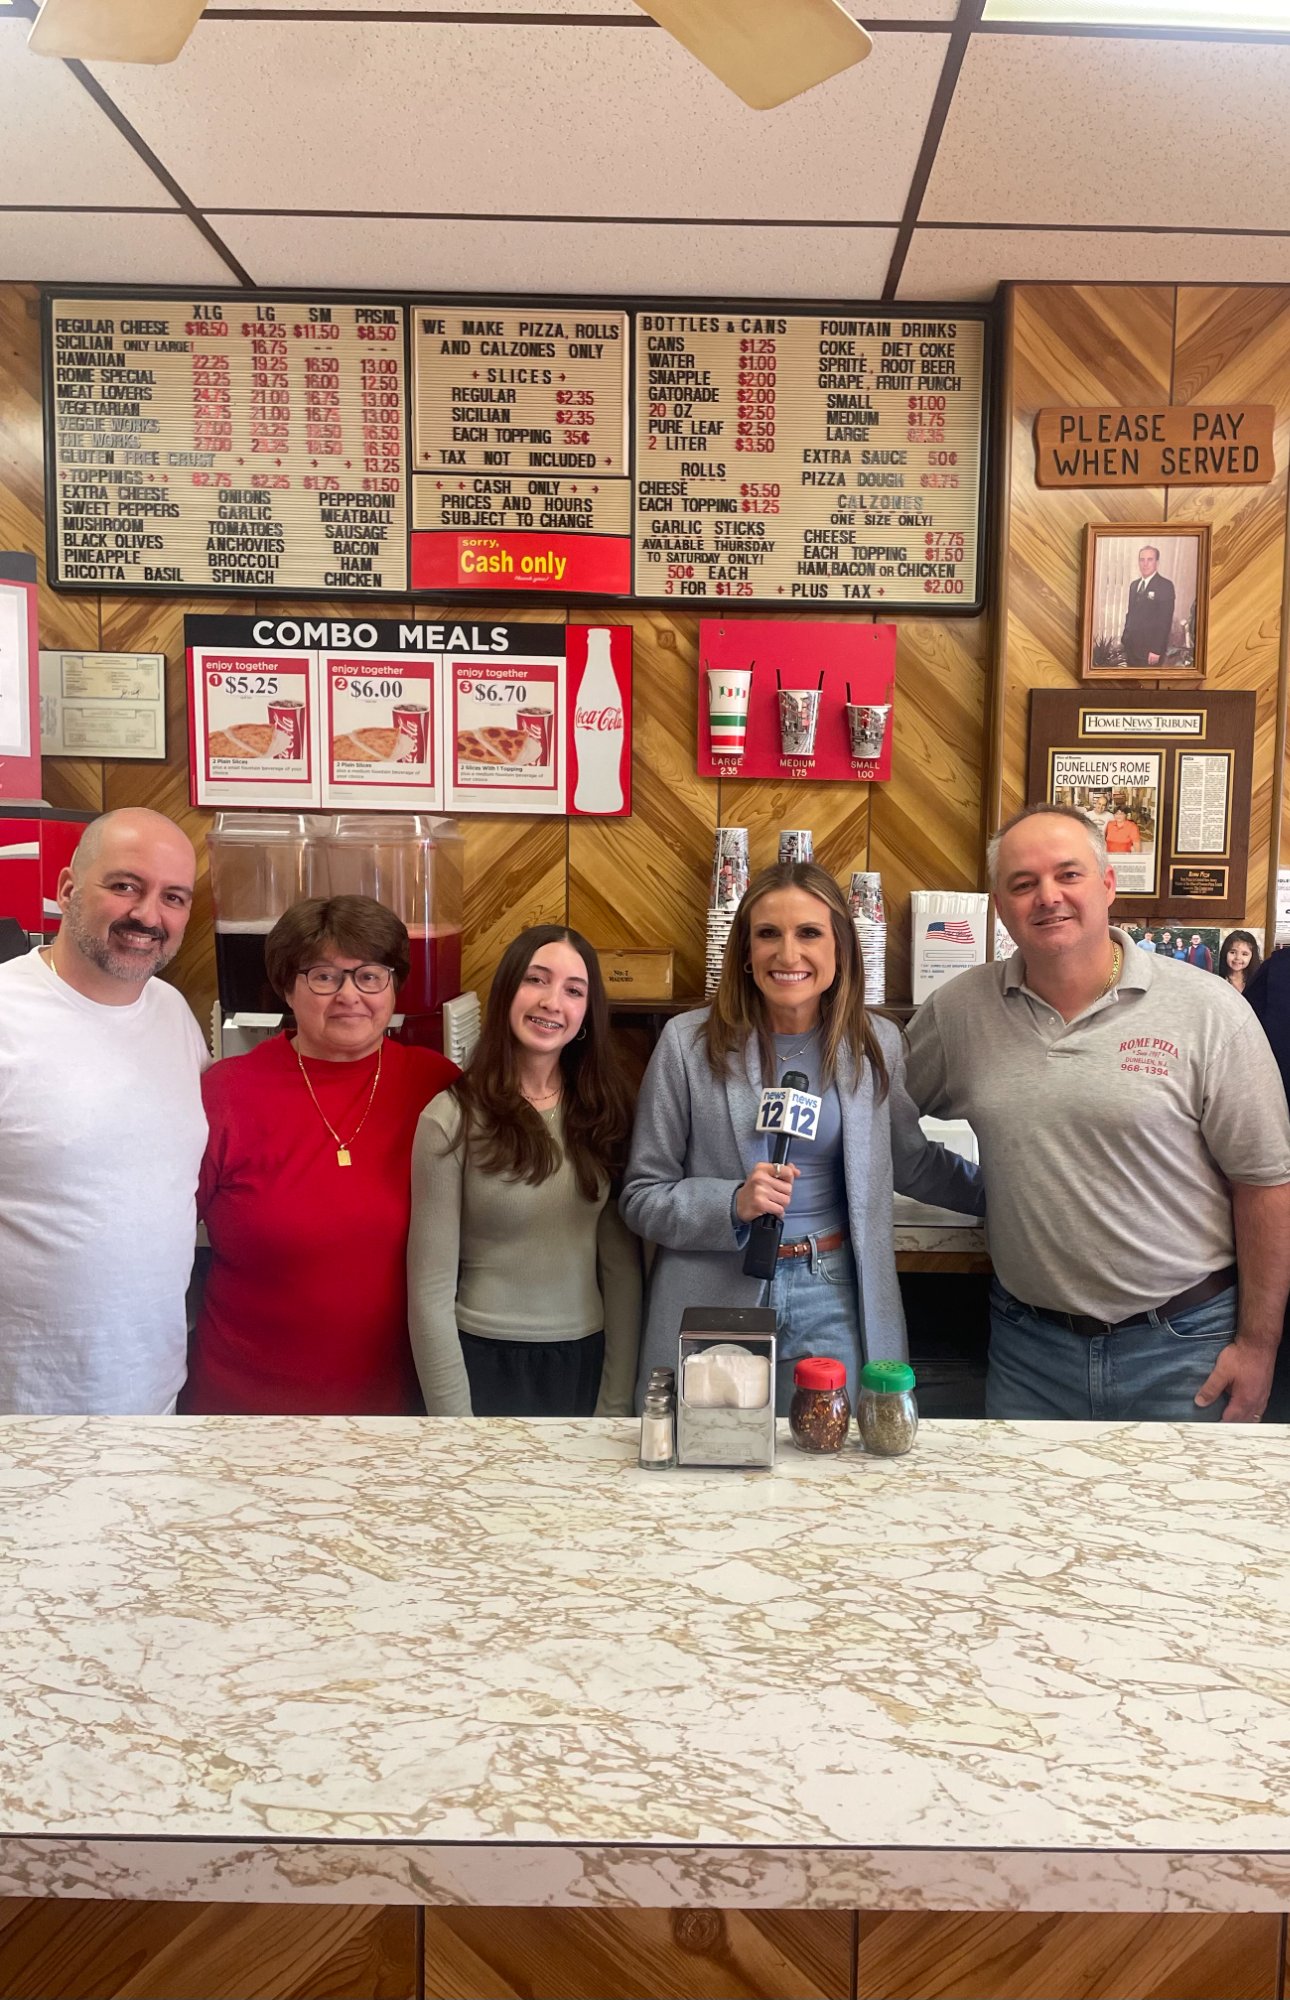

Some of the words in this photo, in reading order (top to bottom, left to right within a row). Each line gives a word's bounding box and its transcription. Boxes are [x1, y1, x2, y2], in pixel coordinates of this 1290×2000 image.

[193, 305, 222, 320] XLG
[257, 306, 275, 321] LG
[309, 308, 332, 322] SM
[56, 319, 114, 334] REGULAR
[120, 320, 169, 335] CHEESE
[423, 320, 445, 334] WE
[462, 320, 504, 336] MAKE
[576, 324, 619, 340] ROLLS
[643, 316, 720, 332] BOTTLES
[742, 319, 786, 334] CANS
[821, 321, 890, 336] FOUNTAIN
[902, 322, 956, 338] DRINKS
[56, 335, 112, 350] SICILIAN
[441, 340, 470, 354] AND
[481, 341, 555, 358] CALZONES
[569, 344, 603, 359] ONLY
[648, 336, 684, 352] CANS
[882, 342, 912, 357] DIET
[920, 344, 955, 358] COKE
[56, 352, 125, 367] HAWAIIAN
[648, 354, 694, 368] WATER
[881, 360, 915, 374] ROOT
[922, 360, 955, 374] BEER
[101, 370, 156, 384] SPECIAL
[648, 370, 710, 385] SNAPPLE
[876, 376, 913, 390] FRUIT
[918, 376, 961, 391] PUNCH
[58, 384, 94, 398] MEAT
[452, 387, 516, 403] REGULAR
[648, 387, 720, 402] GATORADE
[827, 394, 872, 409] SMALL
[452, 408, 510, 423] SICILIAN
[649, 403, 666, 417] 20
[674, 404, 692, 418] OZ
[827, 411, 879, 426] MEDIUM
[649, 420, 682, 434] PURE
[692, 420, 724, 435] LEAF
[1060, 413, 1166, 443] PLEASE
[1192, 413, 1244, 440] PAY
[452, 427, 488, 442] EACH
[495, 428, 551, 444] TOPPING
[649, 436, 656, 450] 2
[667, 437, 706, 450] LITER
[440, 450, 466, 464] TAX
[484, 452, 510, 466] NOT
[529, 452, 596, 468] INCLUDED
[804, 450, 851, 464] EXTRA
[1053, 448, 1140, 476] WHEN
[1161, 446, 1259, 476] SERVED
[681, 462, 726, 477] ROLLS
[802, 472, 846, 486] PIZZA
[63, 485, 108, 500] EXTRA
[118, 486, 168, 501] CHEESE
[474, 480, 511, 494] CASH
[528, 481, 560, 495] ONLY
[639, 481, 688, 496] CHEESE
[320, 492, 394, 508] PEPPERONI
[442, 495, 491, 509] PRICES
[502, 496, 531, 510] AND
[544, 498, 592, 512] HOURS
[639, 498, 672, 511] EACH
[682, 498, 737, 512] TOPPING
[63, 501, 110, 515] SWEET
[118, 502, 179, 517] PEPPERS
[218, 506, 271, 520] GARLIC
[321, 509, 393, 524] MEATBALL
[64, 517, 143, 532] MUSHROOM
[442, 511, 506, 526] SUBJECT
[516, 512, 533, 526] TO
[540, 514, 593, 528] CHANGE
[830, 514, 854, 524] ONE
[864, 515, 891, 525] SIZE
[208, 521, 283, 537] TOMATOES
[325, 524, 388, 540] SAUSAGE
[652, 520, 702, 534] GARLIC
[715, 522, 765, 536] STICKS
[64, 532, 107, 547] BLACK
[115, 534, 163, 549] OLIVES
[804, 530, 856, 544] CHEESE
[206, 538, 284, 553] ANCHOVIES
[334, 541, 378, 555] BACON
[643, 539, 704, 550] AVAILABLE
[714, 540, 774, 552] THURSDAY
[804, 546, 838, 560] EACH
[852, 546, 906, 560] TOPPING
[64, 550, 140, 564] PINEAPPLE
[208, 554, 278, 568] BROCCOLI
[341, 557, 372, 571] HAM
[647, 552, 660, 562] TO
[667, 552, 720, 564] SATURDAY
[65, 564, 124, 580] RICOTTA
[144, 566, 184, 581] BASIL
[461, 550, 513, 573] Cash
[520, 551, 566, 580] only
[898, 563, 955, 578] CHICKEN
[212, 570, 274, 584] SPINACH
[324, 572, 382, 587] CHICKEN
[709, 566, 748, 580] EACH
[665, 581, 673, 594] 3
[681, 581, 706, 595] FOR
[792, 583, 828, 598] PLUS
[842, 584, 871, 598] TAX
[252, 620, 378, 648] COMBO
[400, 626, 509, 651] MEALS
[206, 662, 232, 672] enjoy
[236, 662, 278, 672] together
[332, 666, 358, 676] enjoy
[361, 666, 403, 676] together
[457, 669, 483, 678] enjoy
[486, 669, 528, 679] together
[213, 676, 218, 685] 1
[226, 676, 278, 694] $5.25
[338, 680, 345, 688] 2
[350, 680, 402, 698] $6.00
[462, 682, 470, 692] 3
[475, 684, 526, 702] $6.70
[576, 706, 623, 732] Coca-Cola
[1088, 717, 1120, 728] HOME
[1122, 717, 1152, 728] NEWS
[1154, 718, 1198, 729] TRIBUNE
[712, 758, 743, 766] LARGE
[780, 759, 816, 768] MEDIUM
[850, 761, 880, 770] SMALL
[1056, 762, 1117, 772] DUNELLEN'S
[1120, 762, 1150, 772] ROME
[1056, 774, 1108, 785] CROWNED
[1112, 774, 1150, 786] CHAMP
[1119, 1038, 1150, 1052] ROME
[1152, 1038, 1179, 1059] PIZZA
[1120, 1064, 1168, 1076] 968-1394
[764, 1092, 786, 1100] news
[792, 1094, 818, 1108] news
[762, 1102, 784, 1127] 12
[790, 1105, 816, 1136] 12
